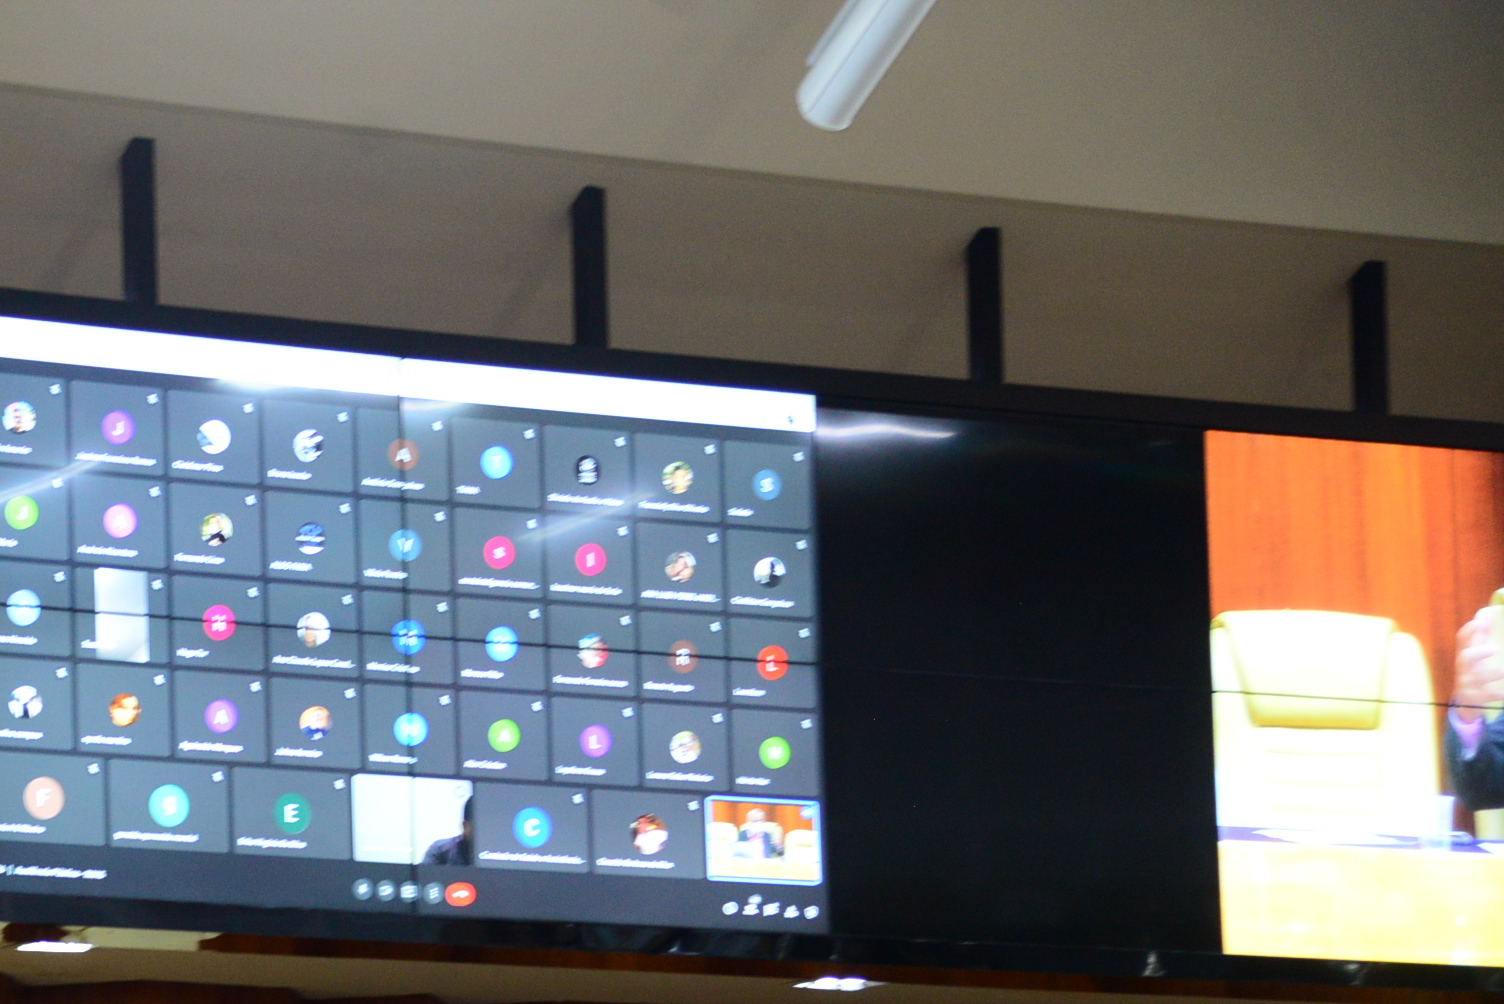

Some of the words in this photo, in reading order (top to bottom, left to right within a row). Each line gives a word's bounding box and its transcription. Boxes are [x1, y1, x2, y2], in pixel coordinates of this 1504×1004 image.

[588, 734, 602, 749] L
[36, 788, 52, 808] F
[283, 804, 300, 822] E
[524, 818, 540, 837] C
